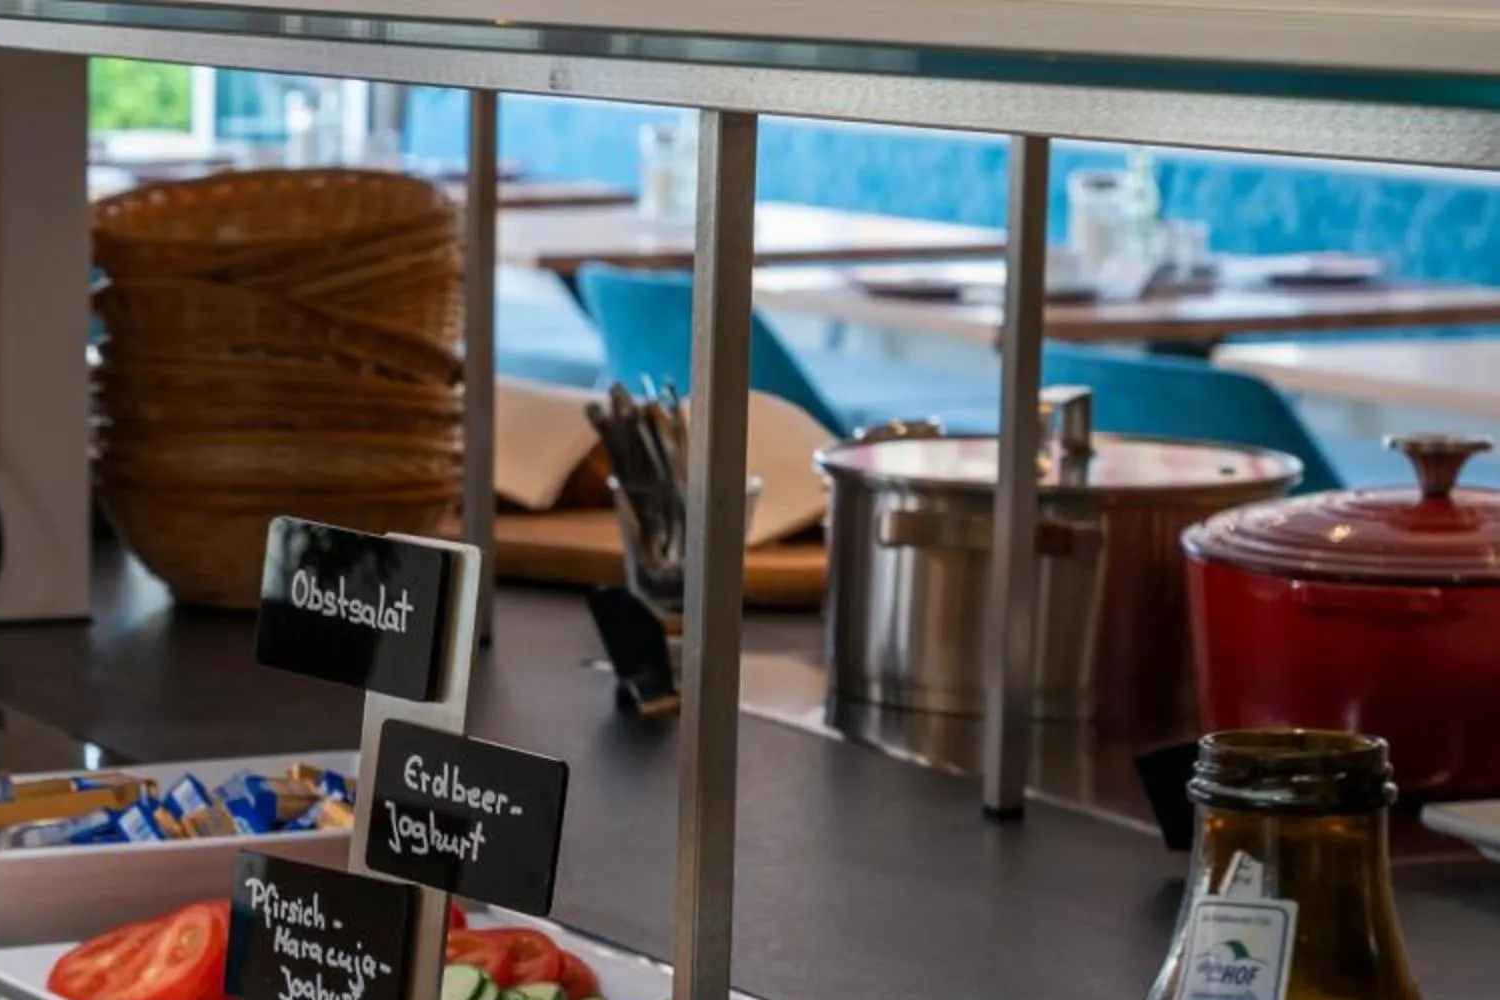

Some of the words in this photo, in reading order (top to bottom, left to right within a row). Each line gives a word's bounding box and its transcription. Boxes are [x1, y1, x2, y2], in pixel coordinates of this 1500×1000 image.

[291, 569, 414, 633] Obstsalat
[403, 754, 523, 815] Erdbeer-
[384, 800, 486, 862] Joghurt
